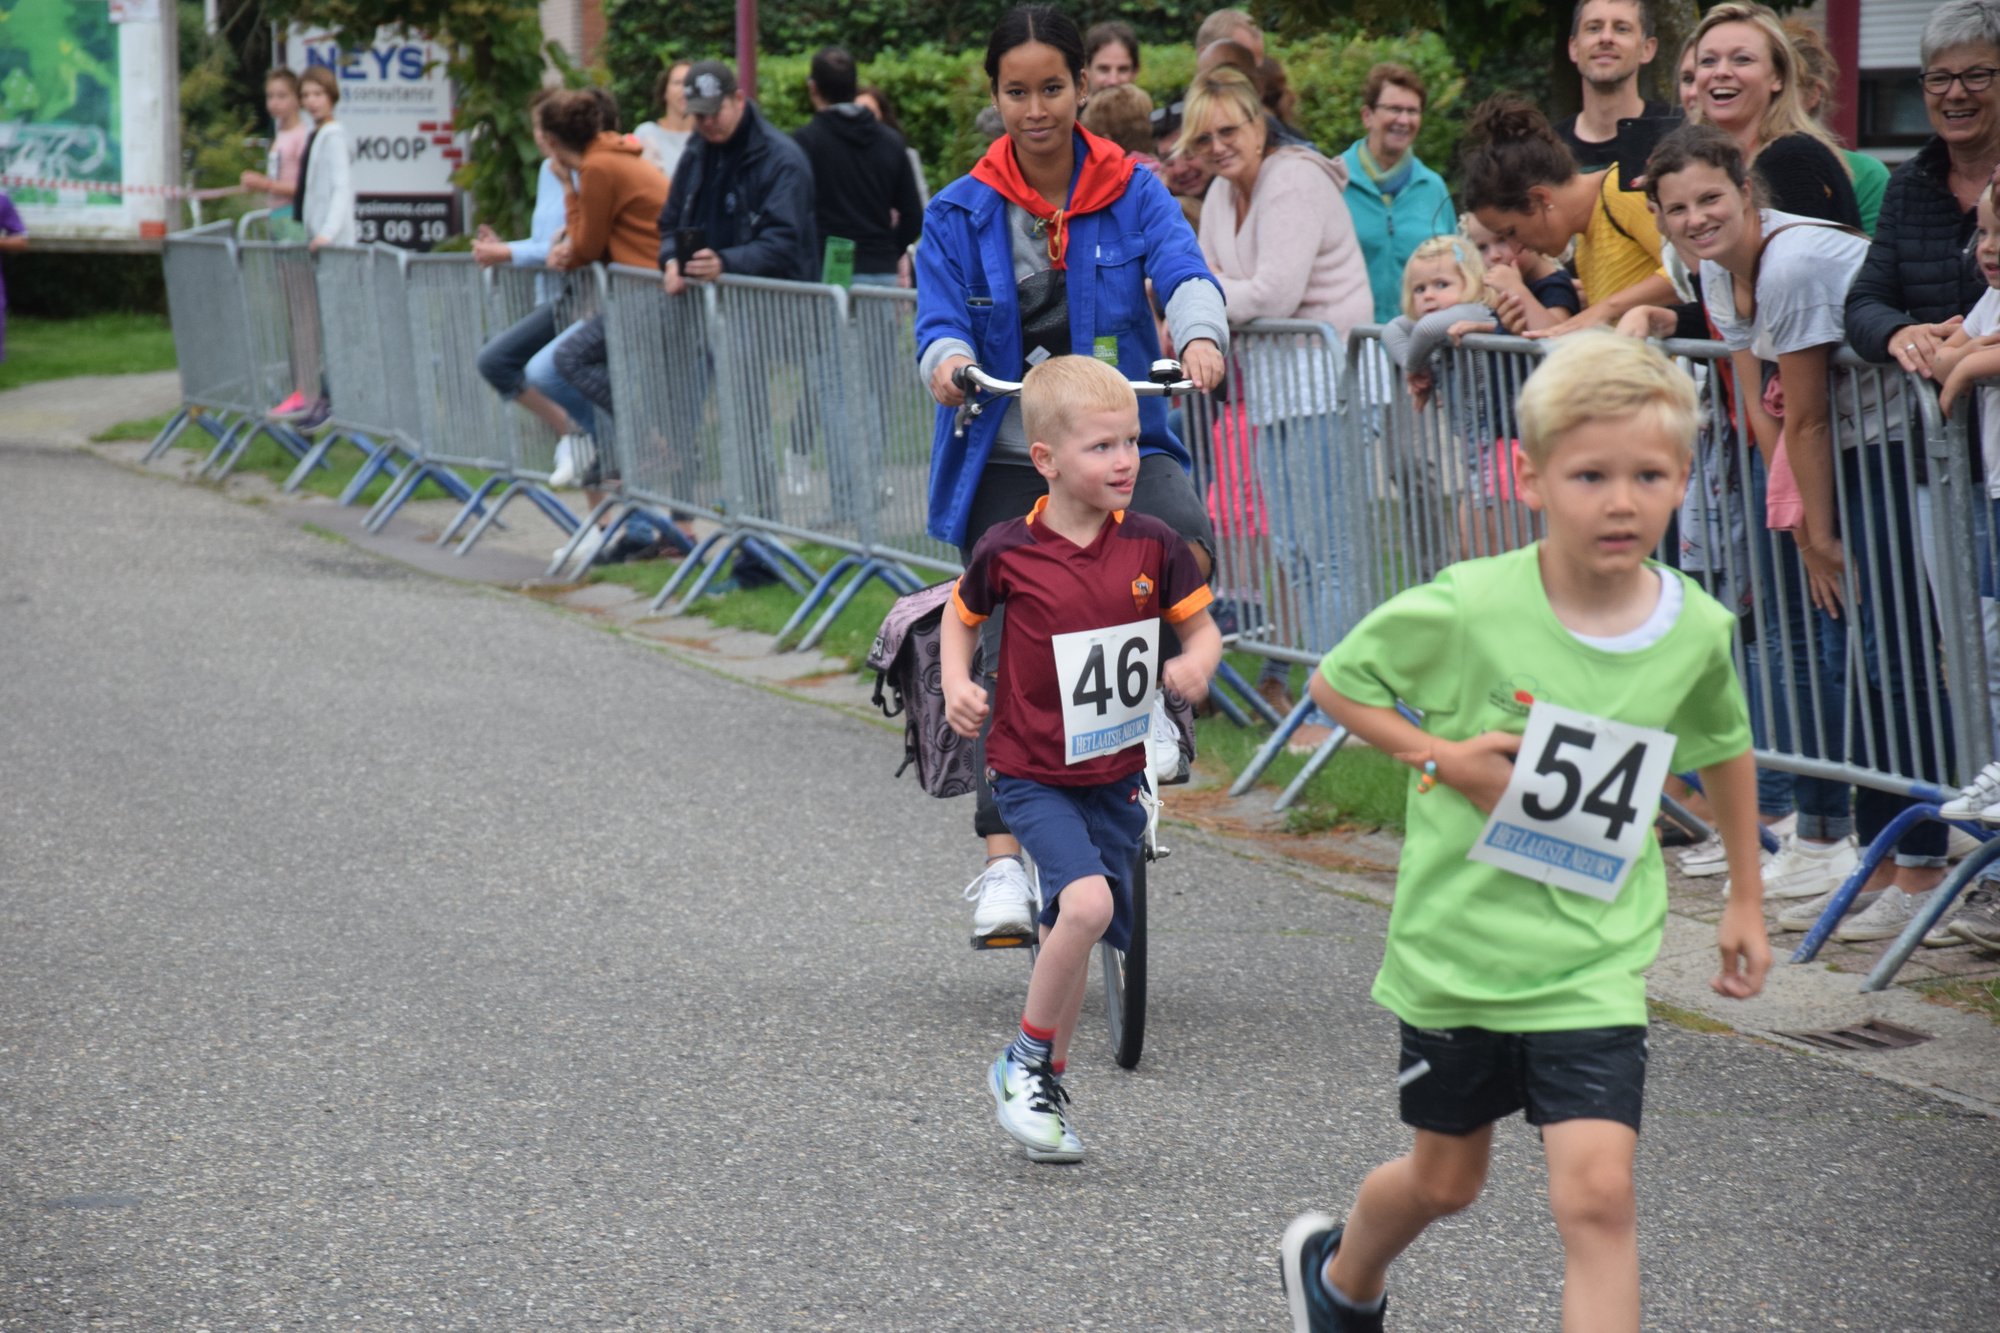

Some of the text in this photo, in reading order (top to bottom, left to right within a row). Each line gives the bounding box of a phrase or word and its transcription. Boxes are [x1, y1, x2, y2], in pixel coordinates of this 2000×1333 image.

[306, 46, 424, 80] NEYS
[356, 137, 426, 161] KOOP
[357, 201, 448, 217] ysimmo.com
[383, 219, 414, 242] 00
[420, 219, 447, 242] 10
[1072, 636, 1149, 716] 46
[1076, 735, 1093, 754] HET
[1521, 723, 1648, 841] 54
[1490, 825, 1521, 850] HET
